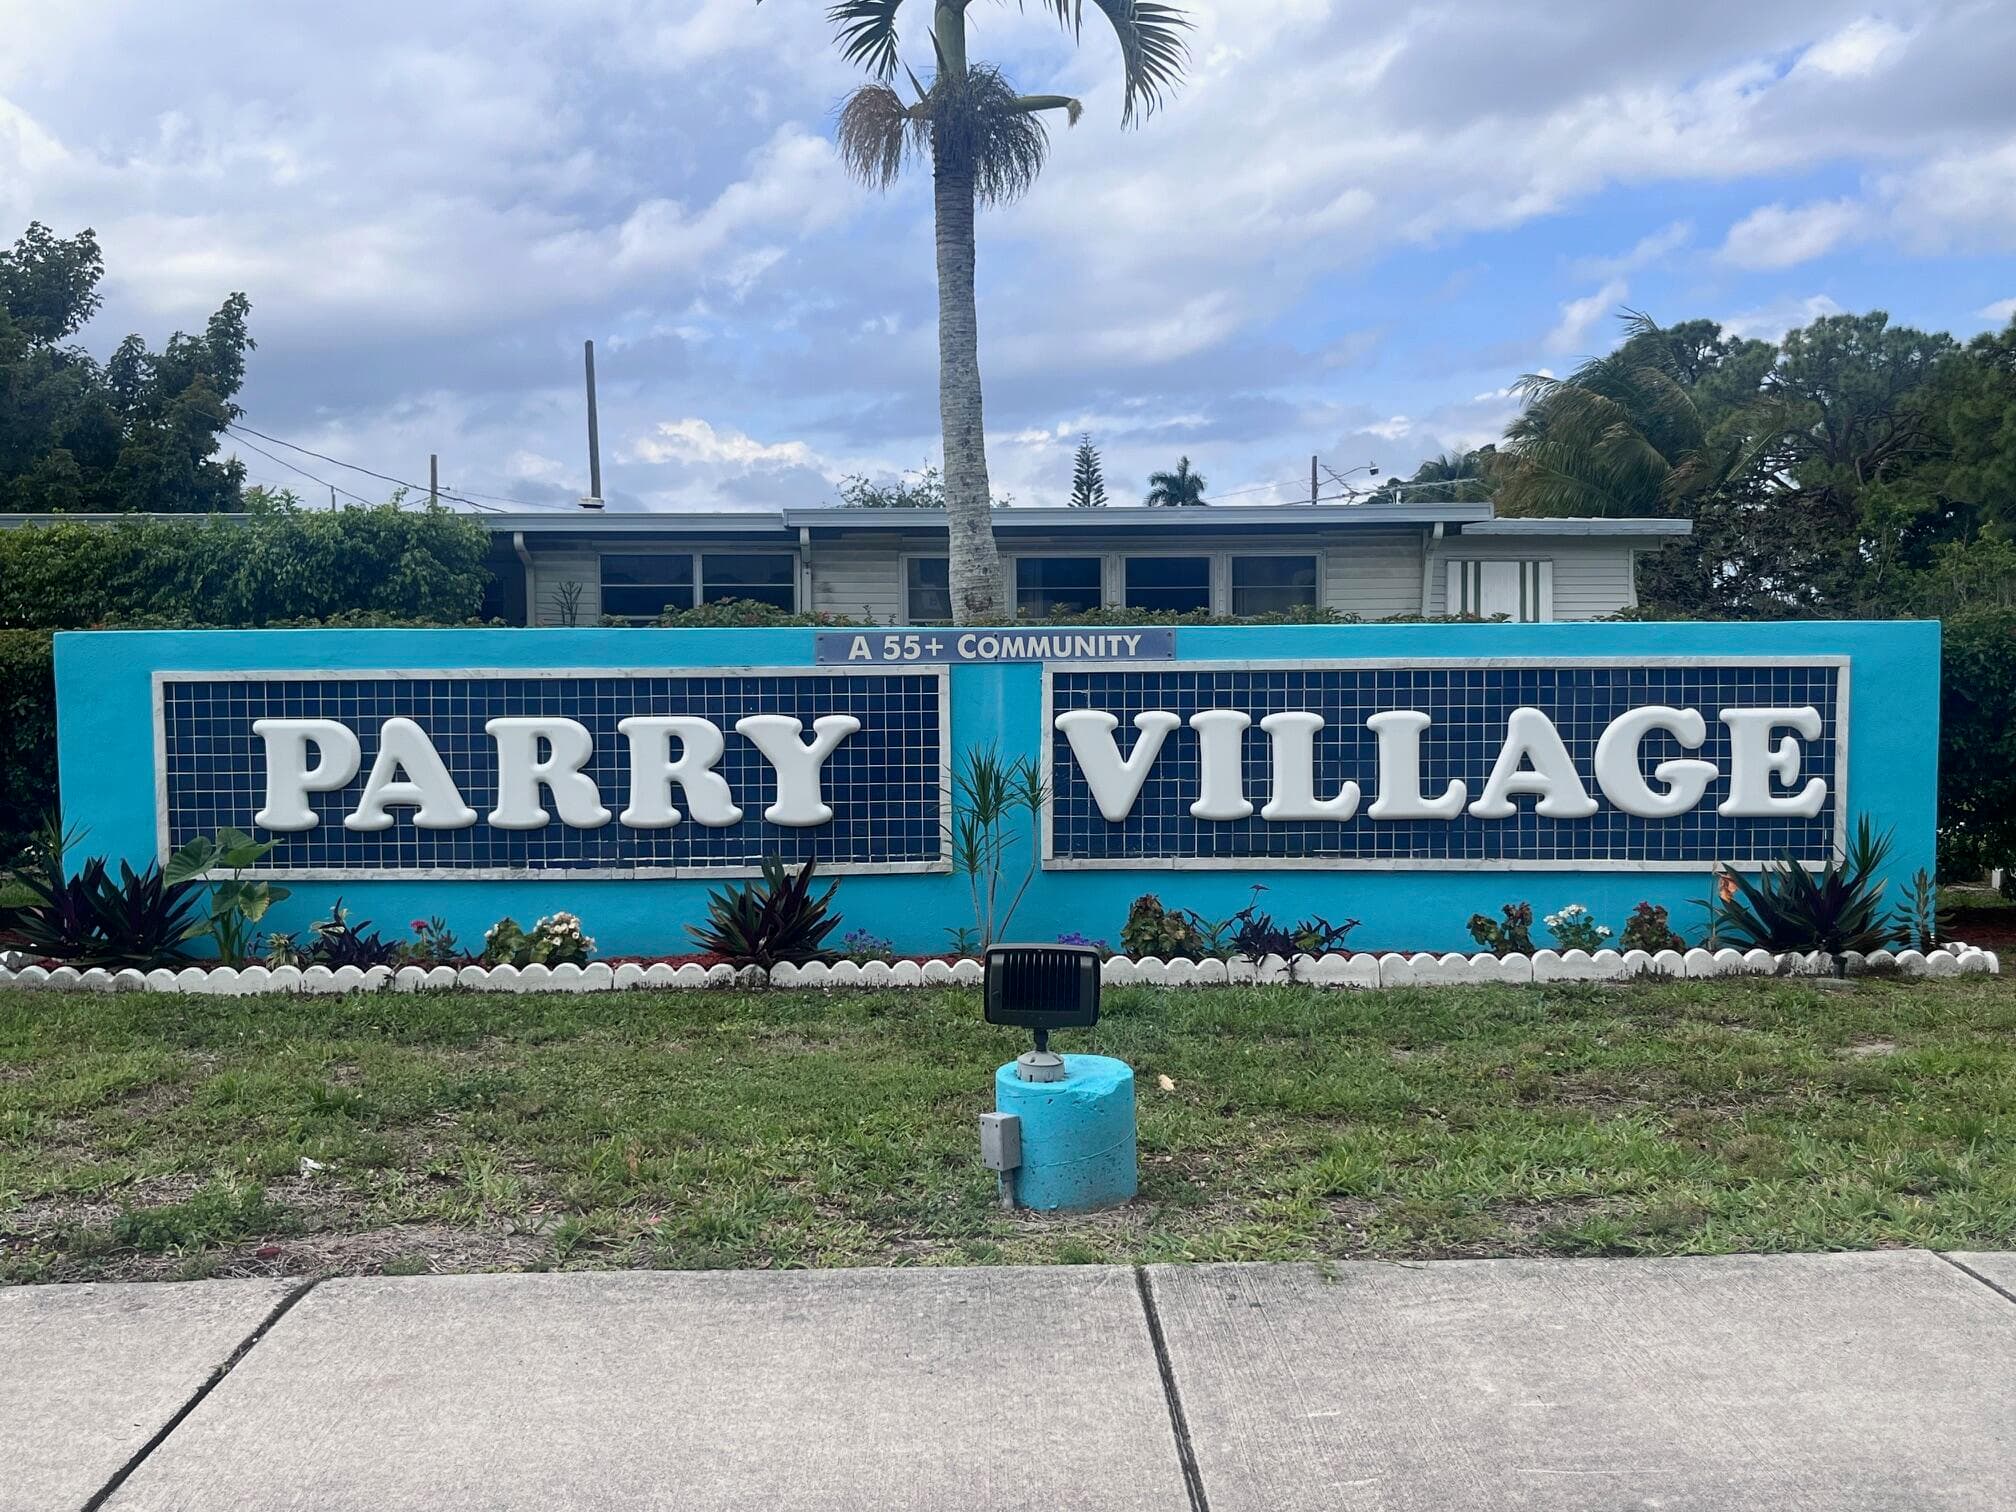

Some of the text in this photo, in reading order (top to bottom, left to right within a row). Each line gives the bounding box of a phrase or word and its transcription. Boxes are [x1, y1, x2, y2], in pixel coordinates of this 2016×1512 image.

[848, 634, 1142, 661] A 55+ COMMUNITY
[252, 705, 1828, 832] PARRY VILLAGE
